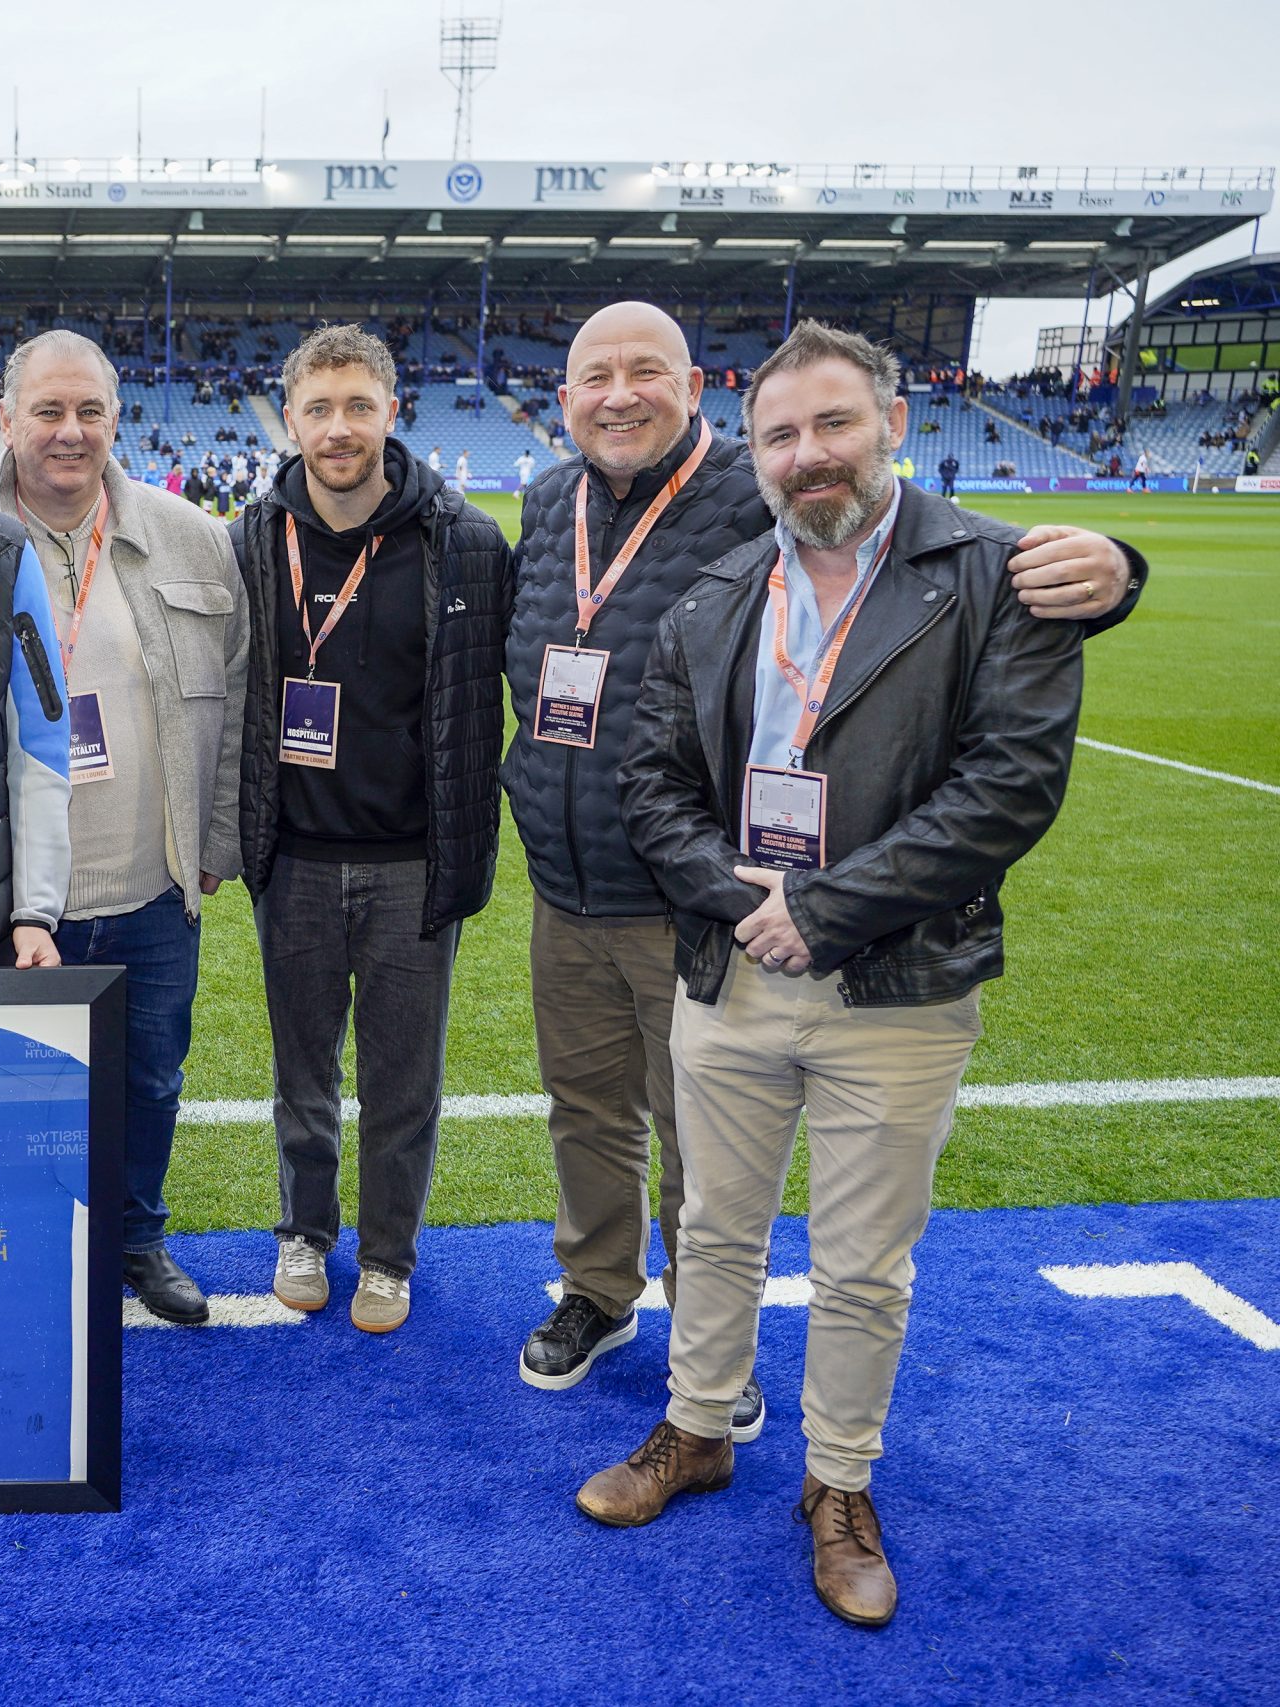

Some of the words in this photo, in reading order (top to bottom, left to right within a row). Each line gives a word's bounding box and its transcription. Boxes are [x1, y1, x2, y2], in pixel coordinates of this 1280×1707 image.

[45, 183, 94, 198] Stand
[324, 164, 398, 201] pmc
[532, 165, 607, 203] pmc
[636, 506, 659, 536] PARTNERS
[620, 536, 639, 560] LOUNGE
[341, 580, 356, 602] LOUNGE
[819, 648, 839, 684] PARTNERS
[287, 728, 329, 742] HOSPITALITY
[69, 743, 101, 757] PITALITY
[310, 756, 329, 765] LOUNGE
[761, 831, 787, 841] PARTNER'S
[787, 835, 806, 845] LOUNGE
[761, 838, 785, 849] EXECUTIVE
[786, 842, 806, 852] SEATING
